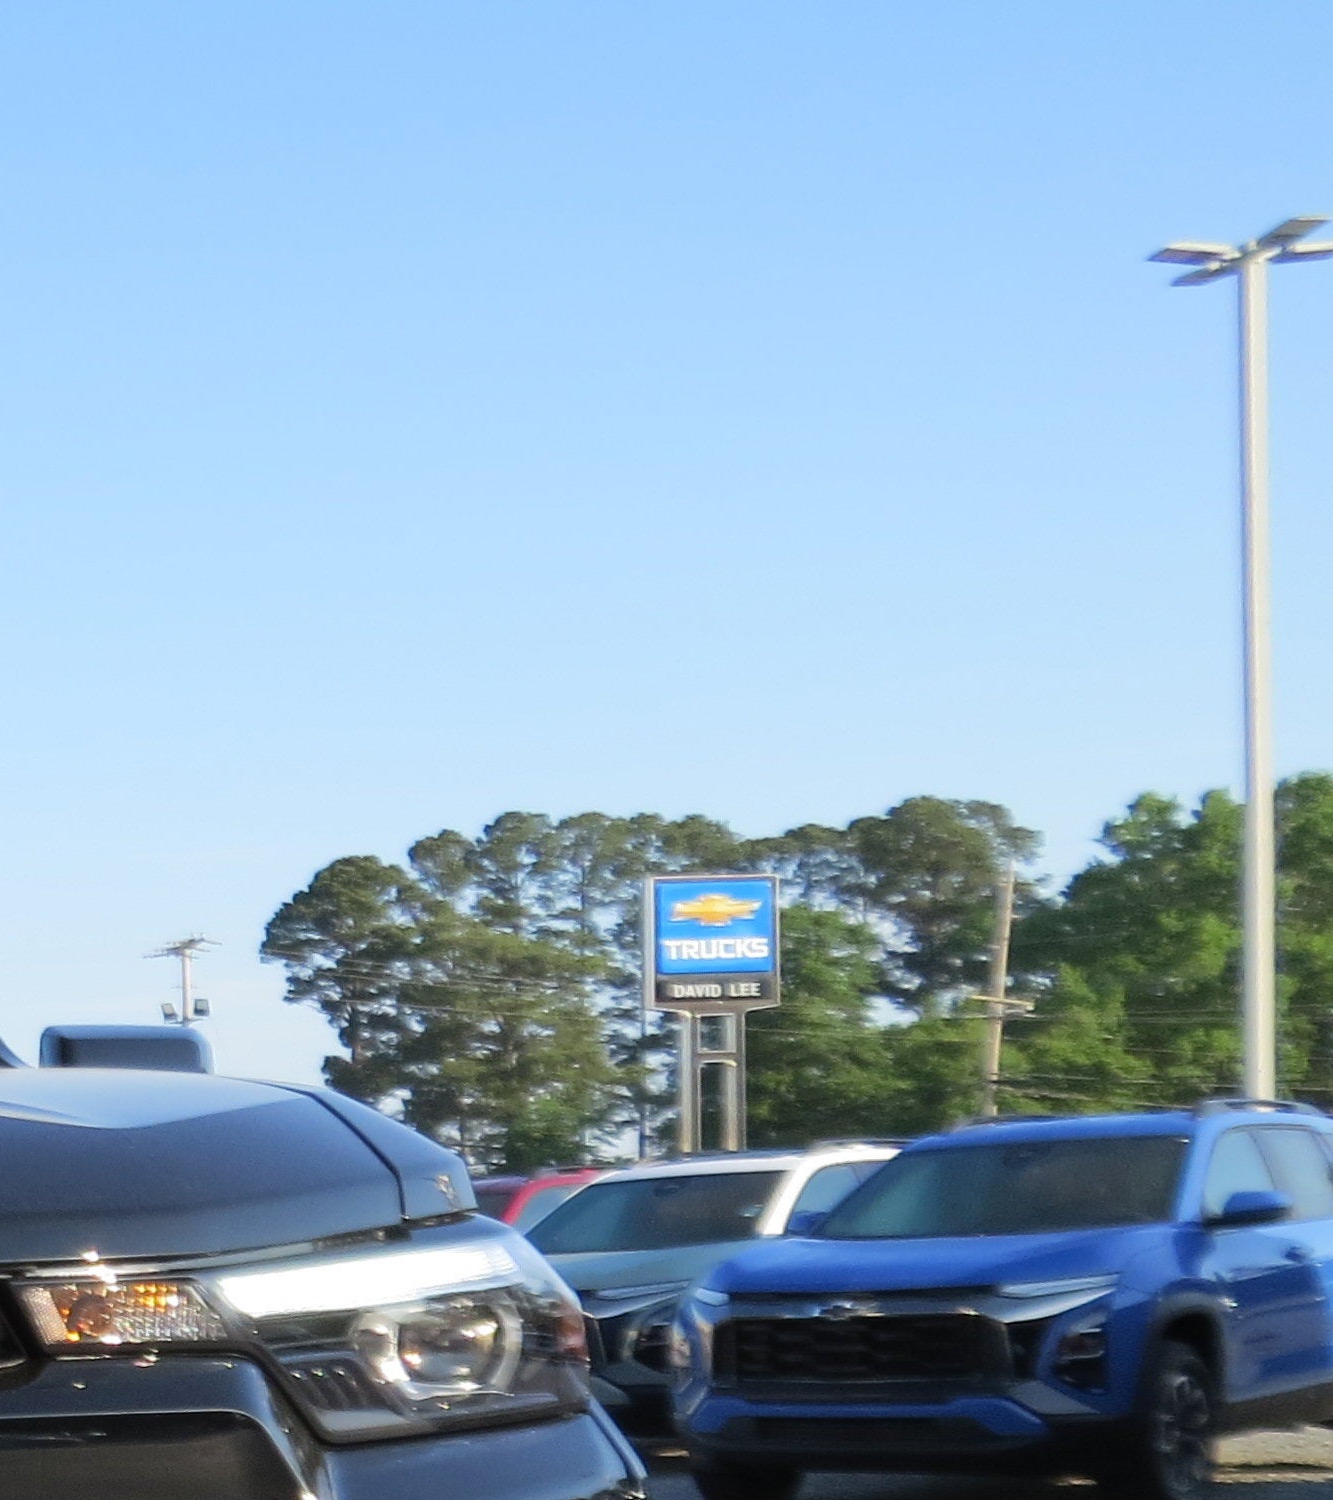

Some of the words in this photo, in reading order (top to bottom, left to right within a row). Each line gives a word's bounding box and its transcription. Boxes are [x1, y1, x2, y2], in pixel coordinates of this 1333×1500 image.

[663, 937, 769, 961] TRUCKS
[674, 983, 722, 999] DAVID
[729, 982, 761, 997] LEE
